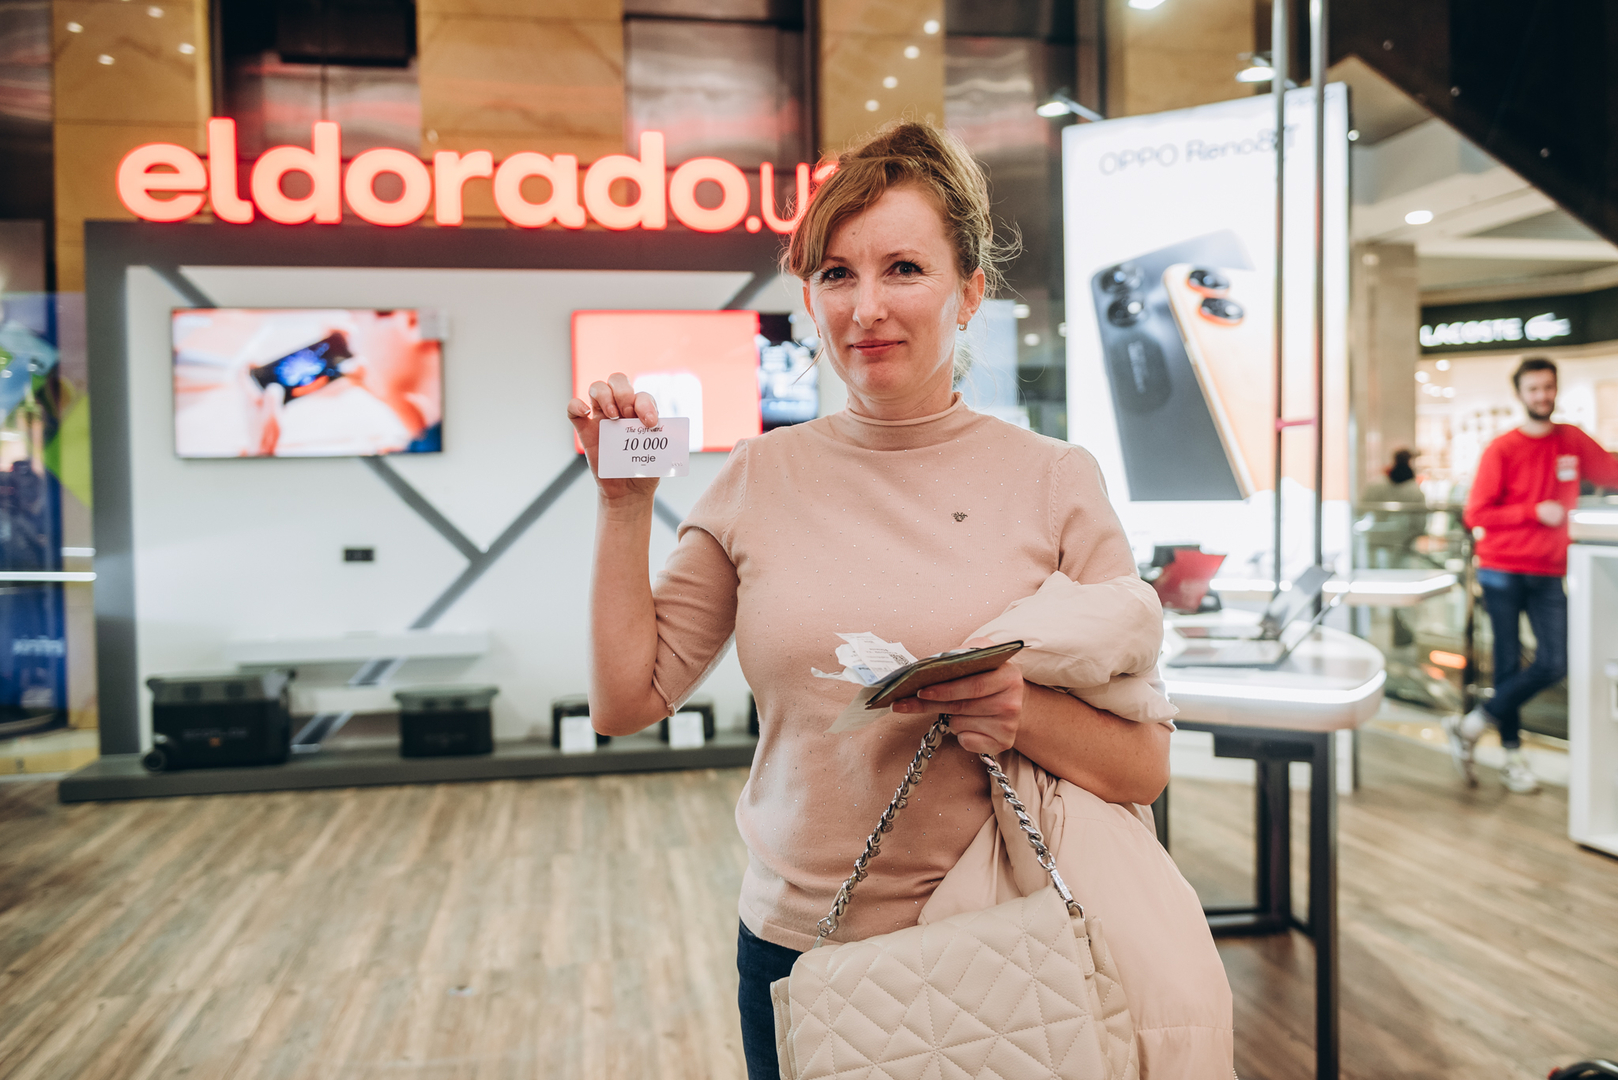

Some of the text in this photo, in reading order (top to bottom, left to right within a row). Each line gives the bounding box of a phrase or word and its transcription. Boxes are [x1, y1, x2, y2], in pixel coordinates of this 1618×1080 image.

[1098, 142, 1179, 176] OPPO
[1419, 317, 1523, 347] LACOSTE
[637, 426, 650, 435] Gift
[622, 436, 669, 451] 10 000
[631, 454, 656, 464] maje
